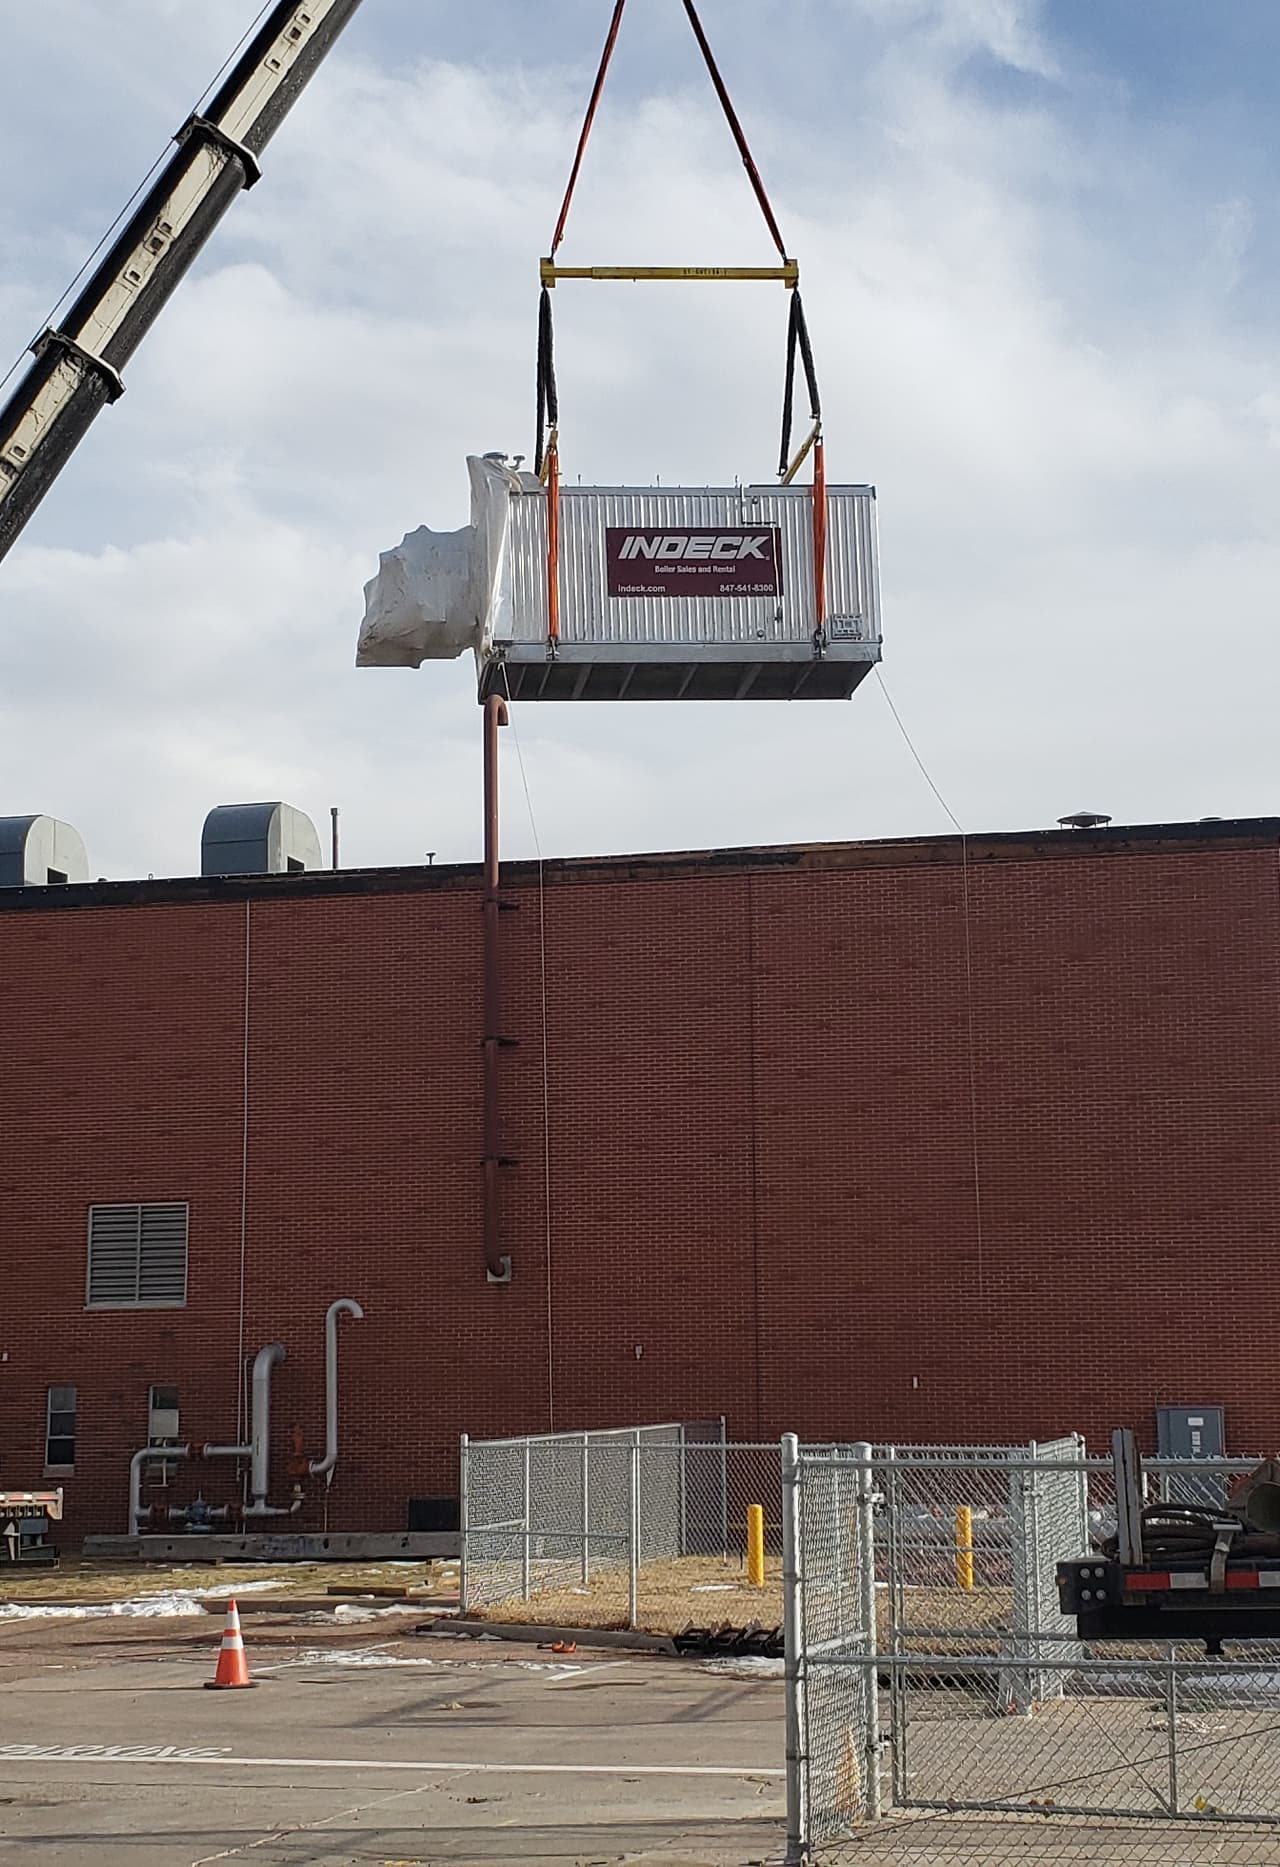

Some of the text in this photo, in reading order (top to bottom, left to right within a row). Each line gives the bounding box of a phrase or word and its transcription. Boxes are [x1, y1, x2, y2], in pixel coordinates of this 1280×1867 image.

[618, 536, 769, 560] INDECK
[654, 565, 736, 573] Boiler Sales and Rental
